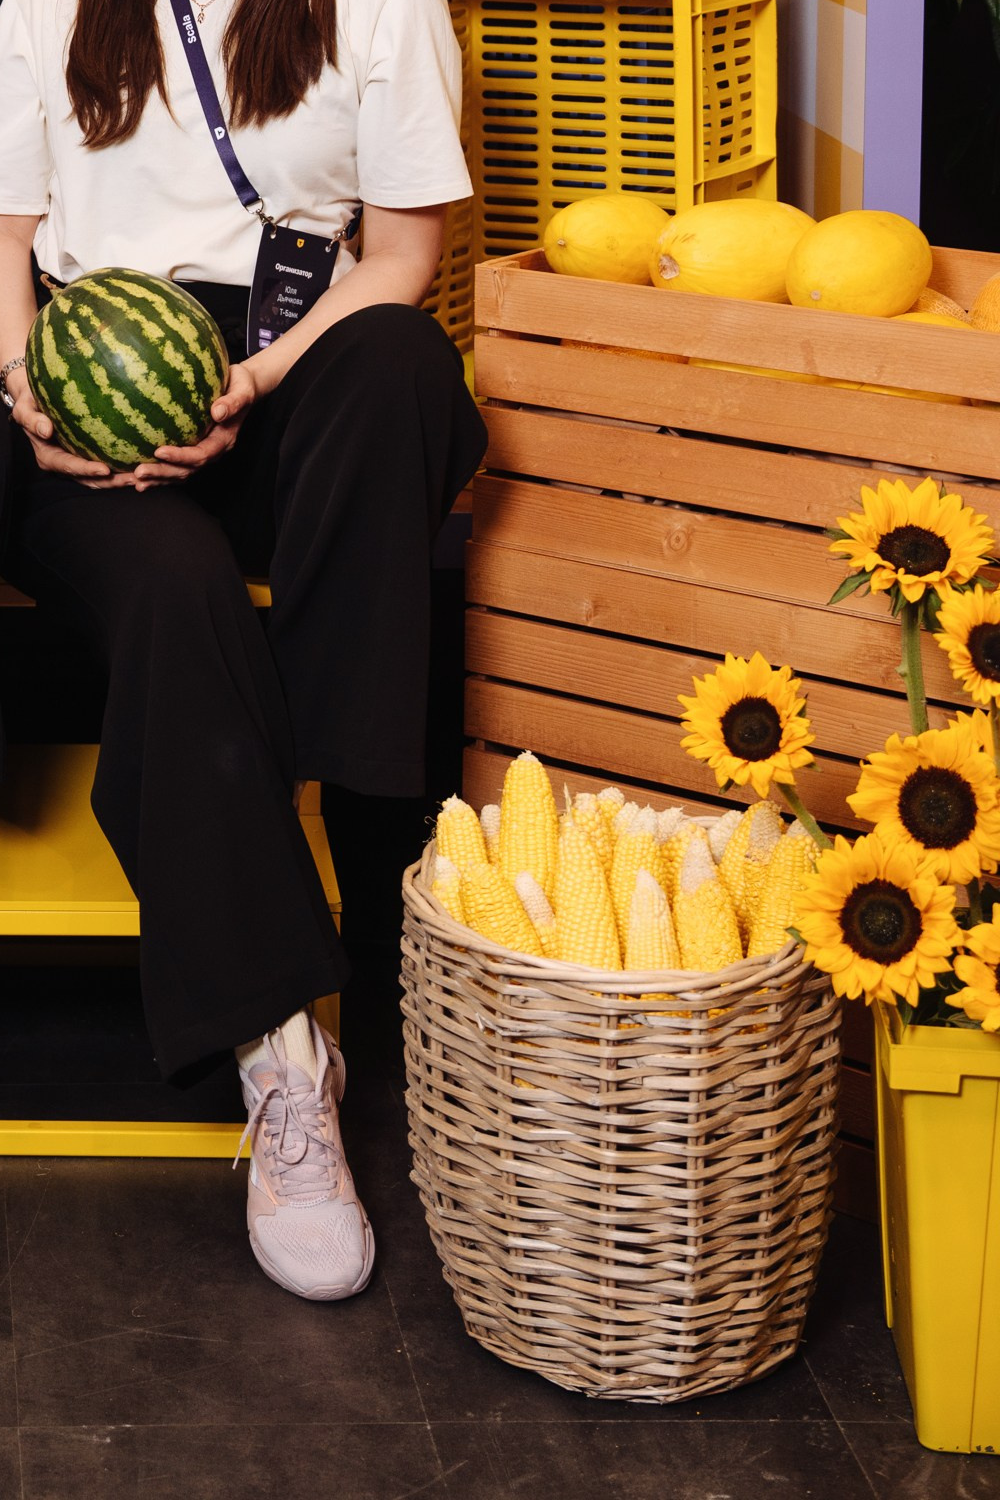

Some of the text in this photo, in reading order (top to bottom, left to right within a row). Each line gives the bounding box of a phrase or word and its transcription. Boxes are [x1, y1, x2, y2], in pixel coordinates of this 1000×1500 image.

[182, 14, 197, 44] Scala
[275, 262, 313, 279] Организатор
[284, 285, 298, 295] Юля
